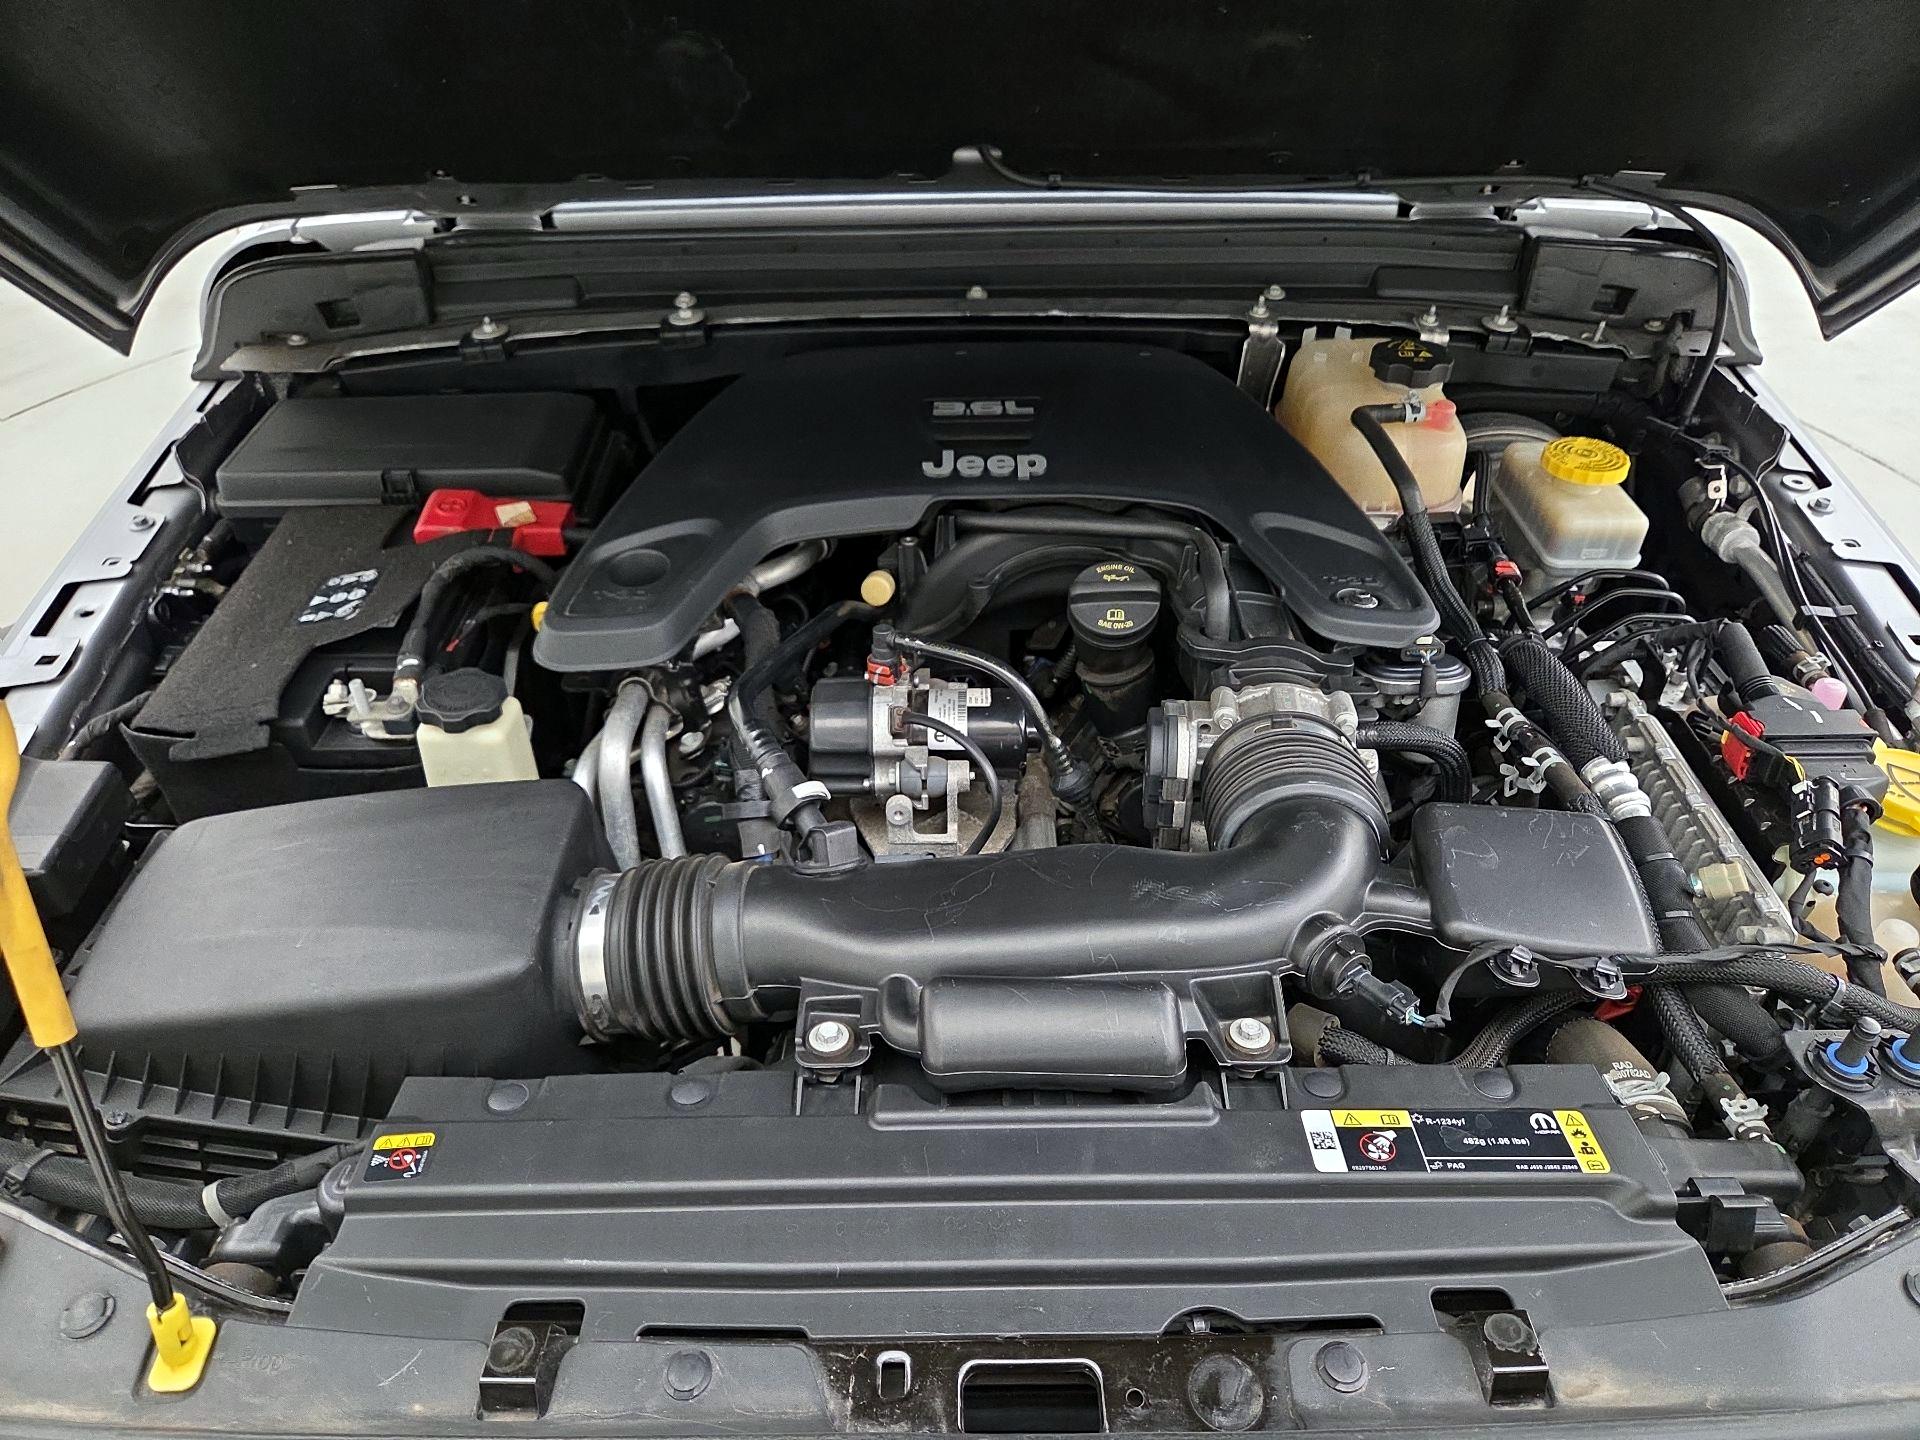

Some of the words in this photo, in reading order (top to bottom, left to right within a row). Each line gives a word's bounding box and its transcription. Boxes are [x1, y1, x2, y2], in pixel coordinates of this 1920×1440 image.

[921, 449, 1047, 480] Jeep
[1095, 564, 1123, 574] ENGINE
[1123, 565, 1135, 574] OIL
[1097, 619, 1112, 629] SAE
[1612, 1060, 1633, 1070] RAD
[1425, 1117, 1466, 1127] R-1234yf
[1463, 1137, 1487, 1146] 482g
